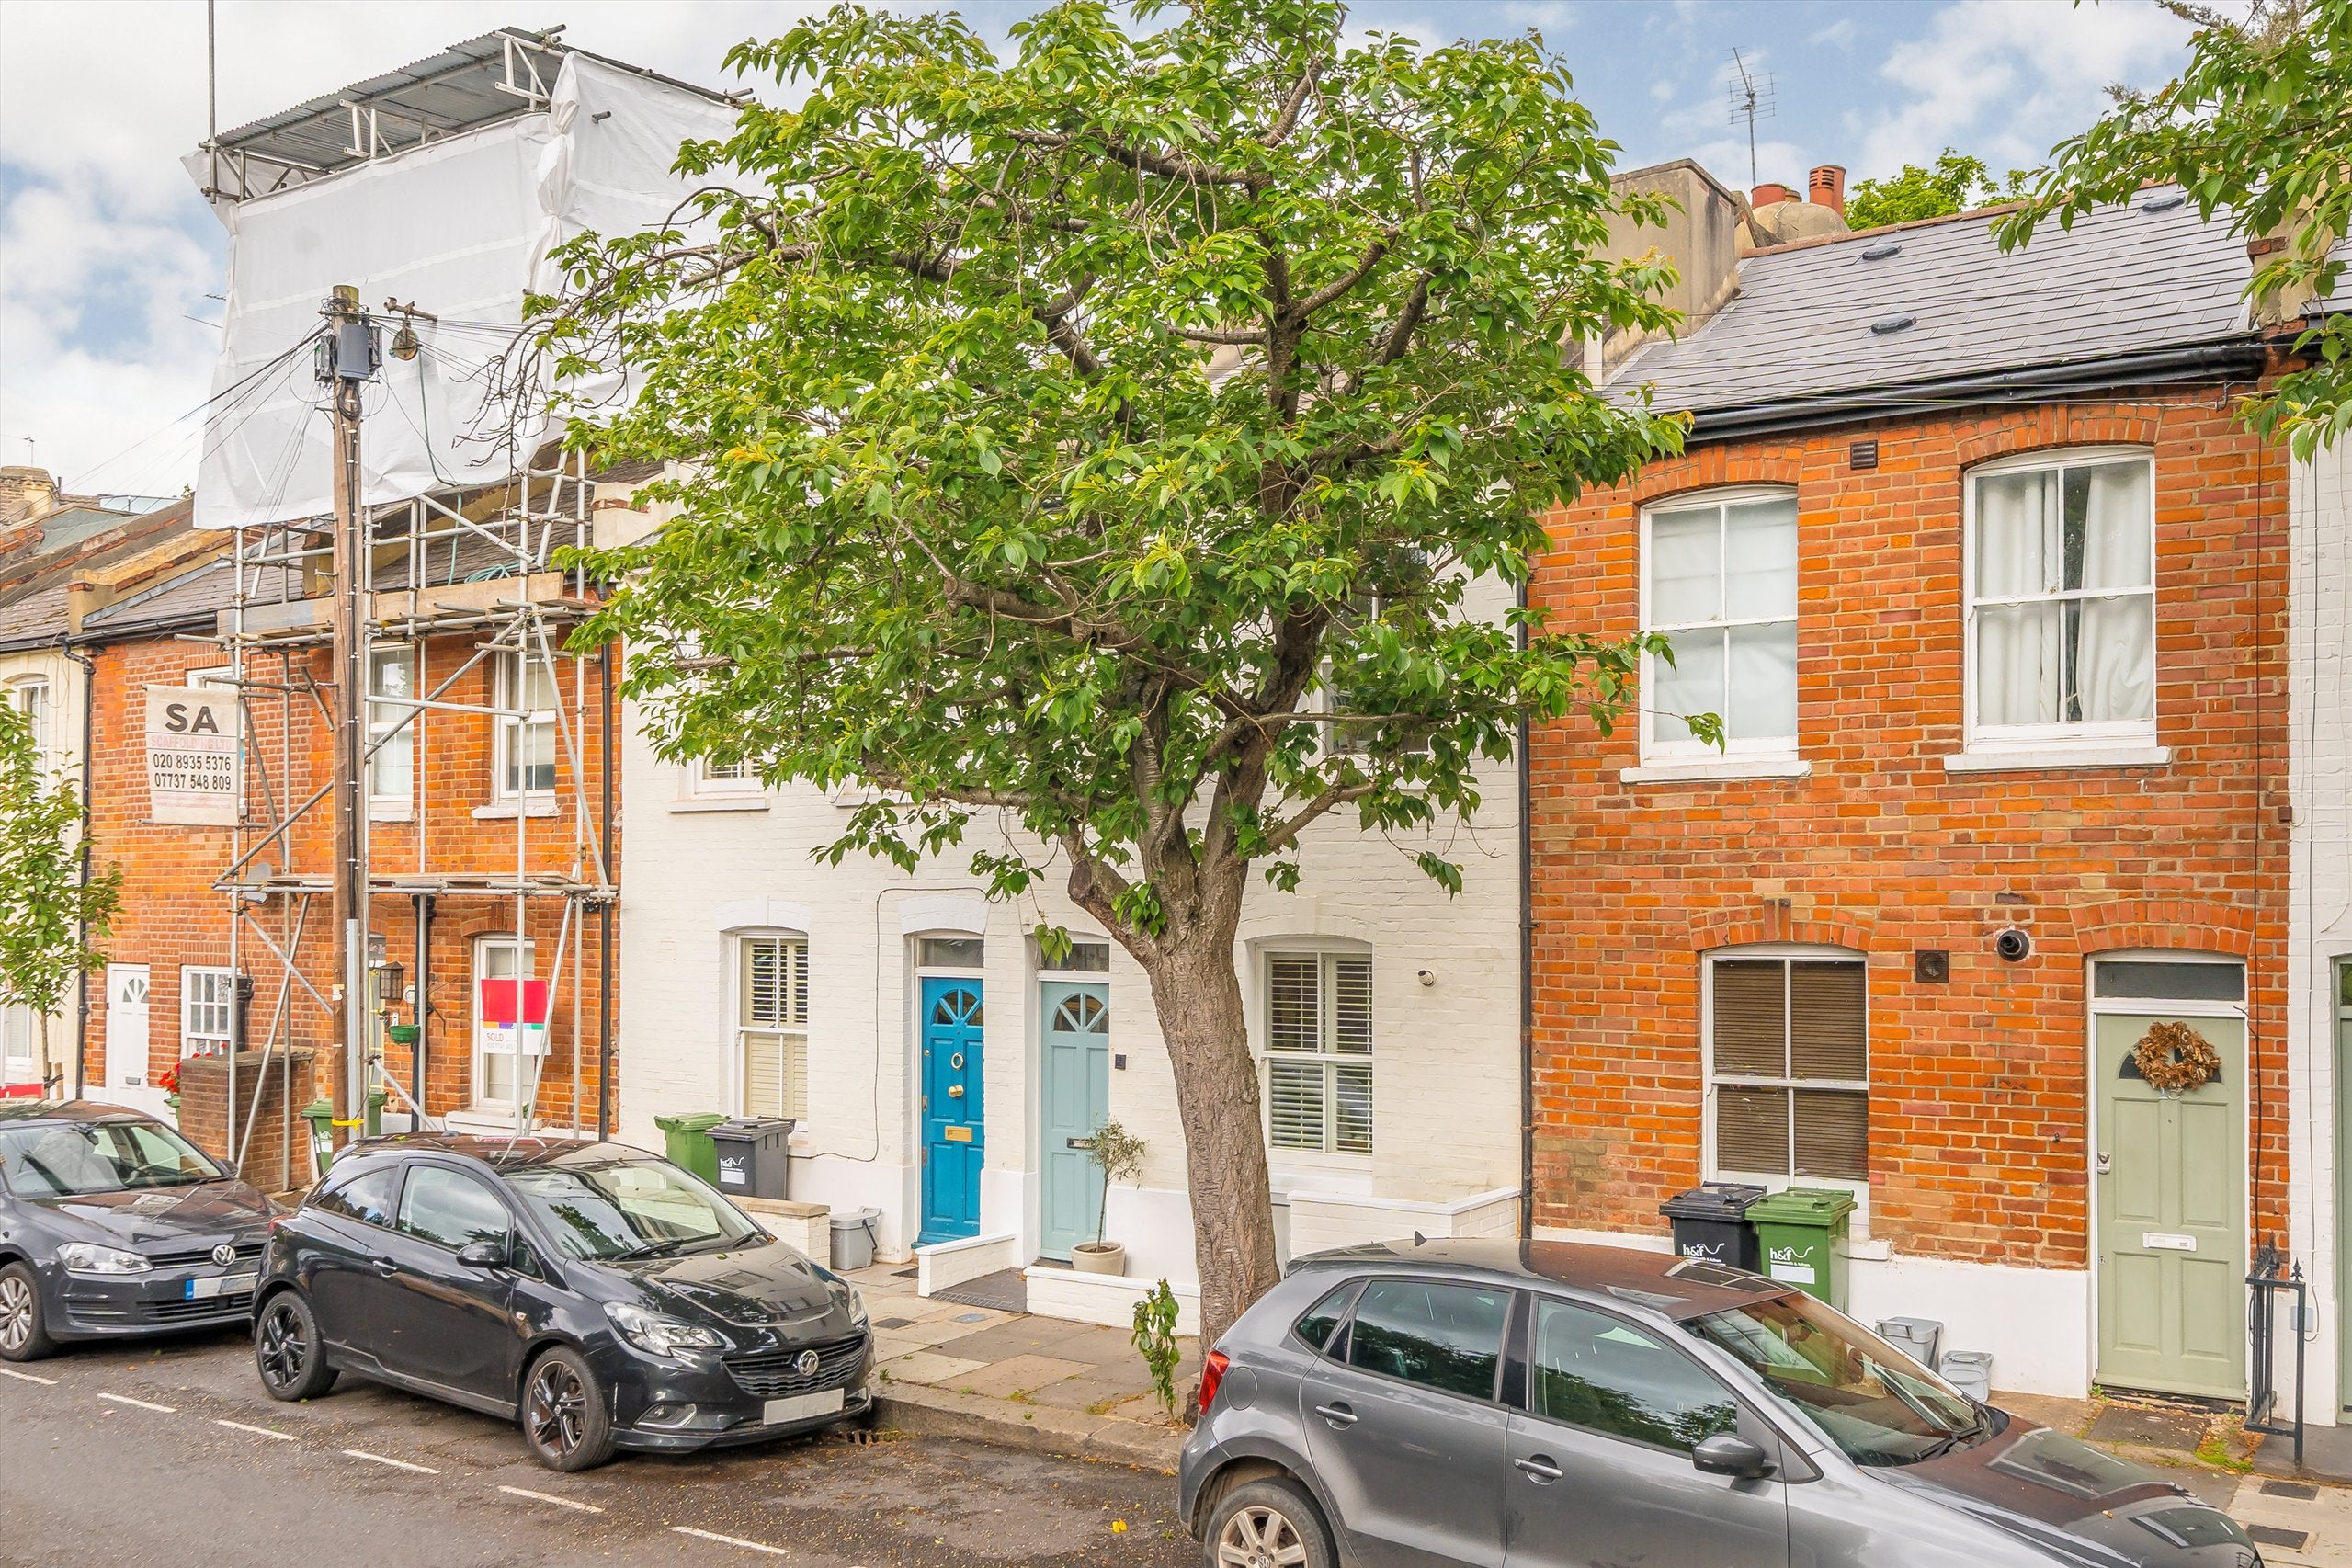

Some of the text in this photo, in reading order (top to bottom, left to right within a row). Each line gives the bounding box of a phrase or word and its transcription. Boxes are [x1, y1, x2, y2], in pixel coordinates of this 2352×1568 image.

[165, 703, 219, 733] SA
[151, 735, 232, 751] SCAFFOLDING LTD
[153, 753, 232, 771] 020 8935 5376
[154, 772, 232, 790] 07737 548 809
[486, 1031, 505, 1042] SOLD
[1682, 1244, 1704, 1257] h&f
[1769, 1247, 1792, 1261] h&f
